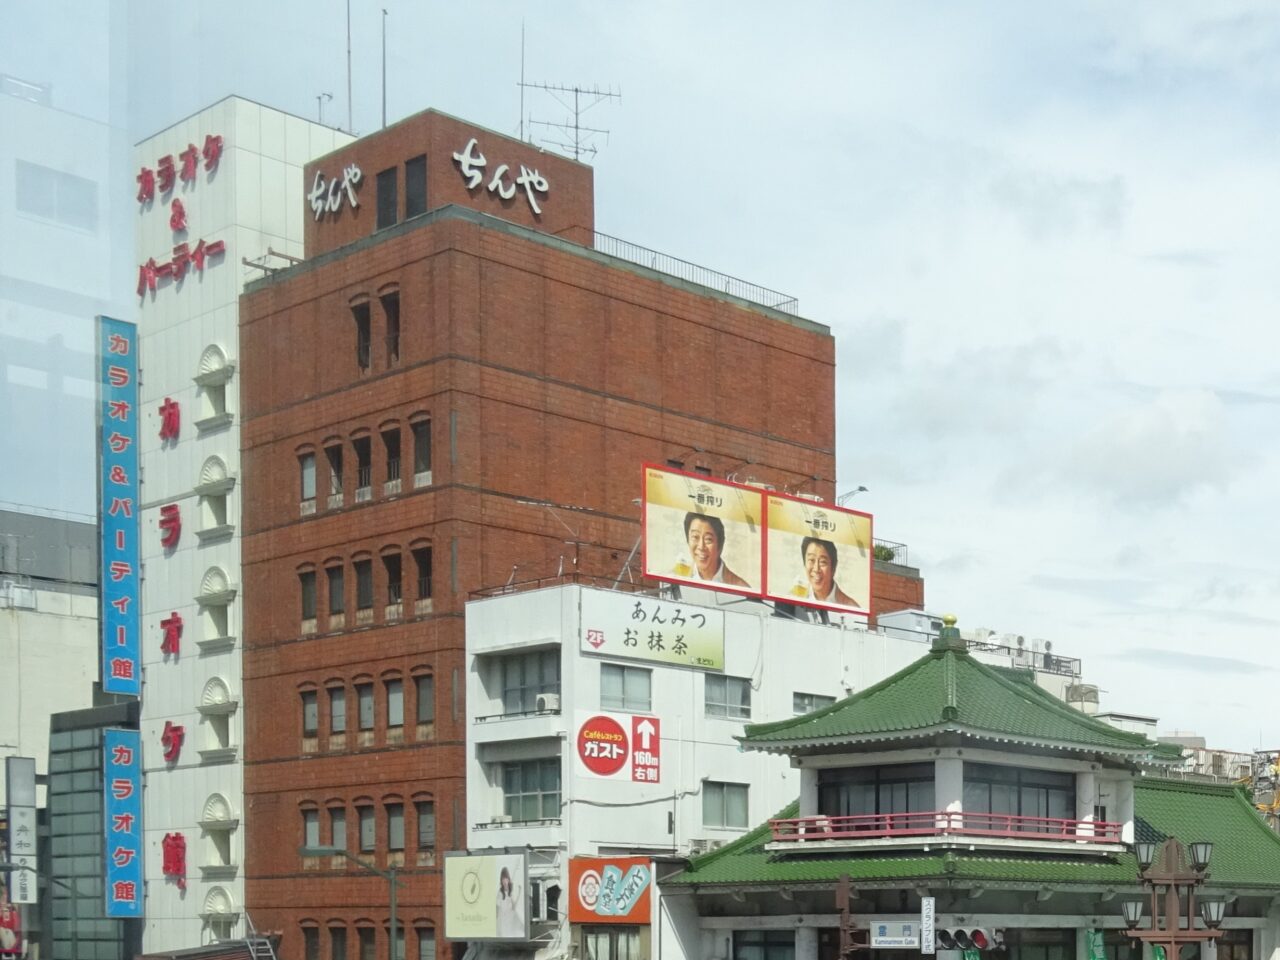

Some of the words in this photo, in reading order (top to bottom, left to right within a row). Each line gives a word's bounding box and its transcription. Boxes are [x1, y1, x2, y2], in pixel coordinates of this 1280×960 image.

[136, 134, 224, 205] カラオケ
[453, 138, 549, 214] ちんや
[307, 164, 362, 221] ちんや
[170, 198, 187, 233] &
[136, 239, 226, 297] パーティー
[107, 334, 134, 681] カラオケ&パーティー館
[632, 601, 706, 629] あんみつ
[588, 631, 604, 644] 2F
[623, 628, 688, 655] お抹茶
[584, 741, 624, 759] ガスト
[634, 751, 659, 766] 160m
[635, 767, 658, 781] 右側
[112, 746, 135, 901] カラオケ館
[878, 925, 912, 937] 雷門
